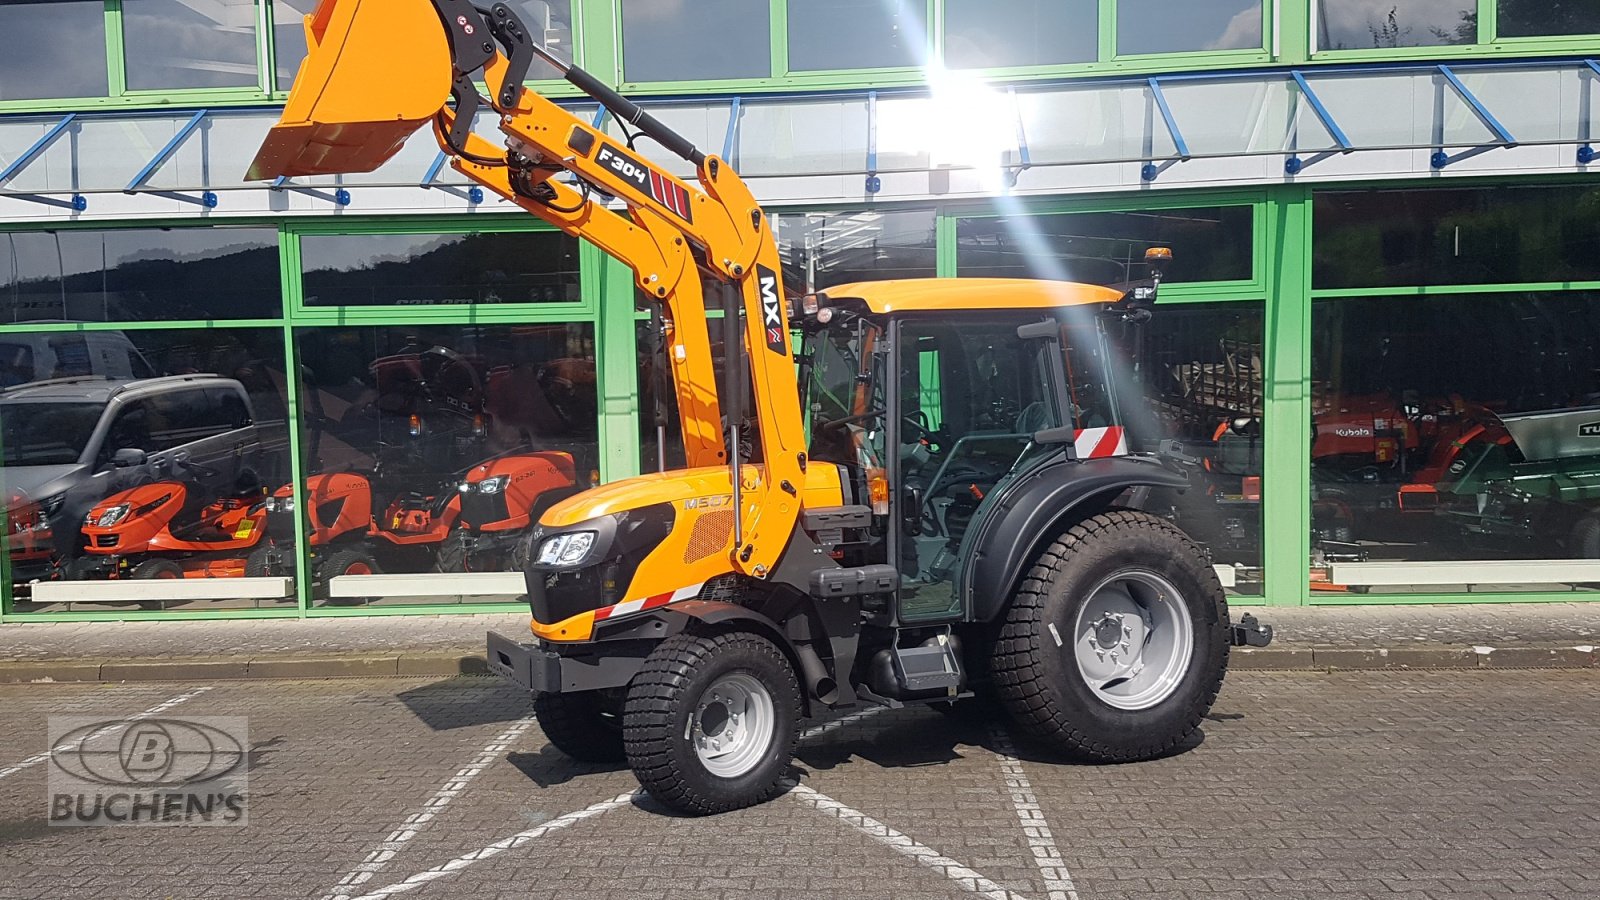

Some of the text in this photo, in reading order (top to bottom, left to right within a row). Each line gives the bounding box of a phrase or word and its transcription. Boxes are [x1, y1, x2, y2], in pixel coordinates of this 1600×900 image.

[599, 148, 646, 184] F 304
[760, 276, 781, 327] MX
[1335, 427, 1370, 437] Kubota
